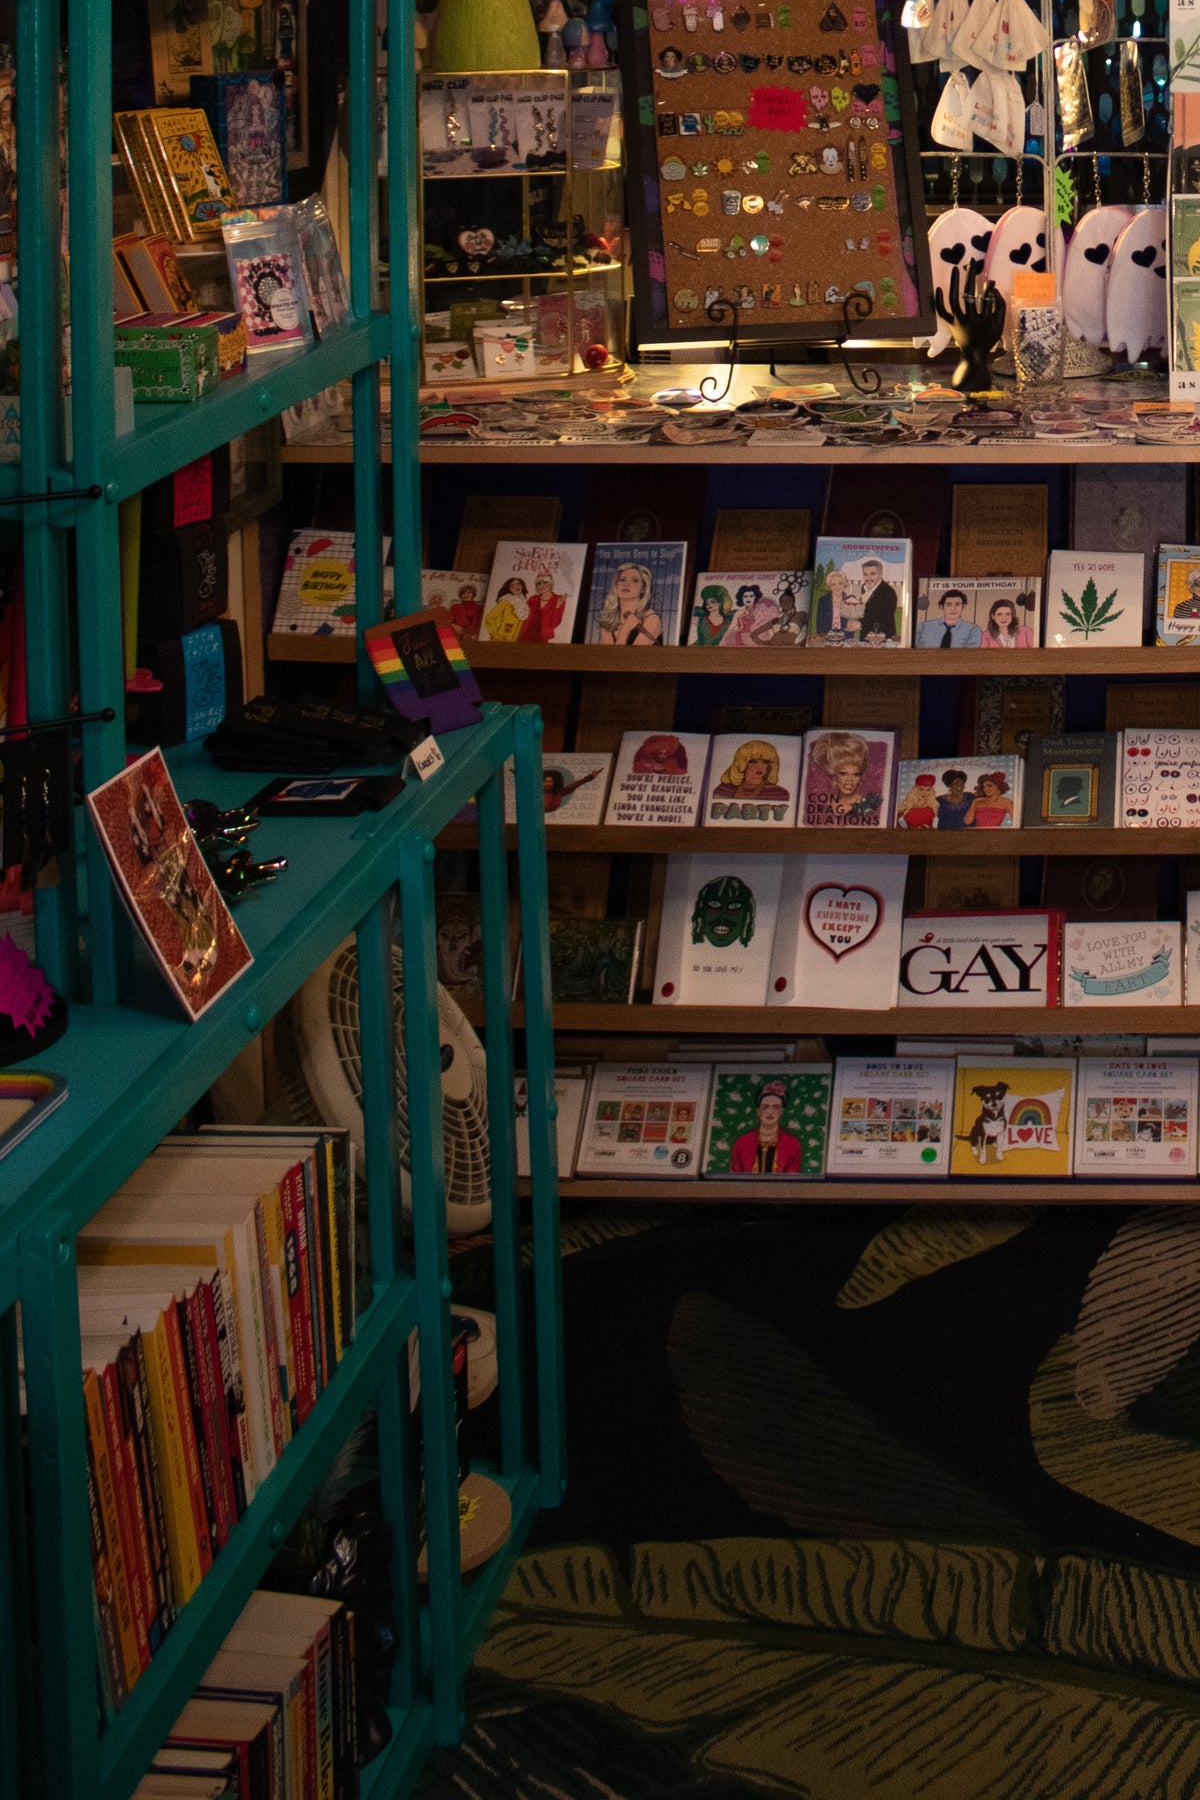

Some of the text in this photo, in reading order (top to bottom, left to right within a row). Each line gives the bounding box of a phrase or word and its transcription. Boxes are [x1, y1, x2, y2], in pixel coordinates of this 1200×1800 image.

[1168, 621, 1195, 634] Happy
[628, 794, 667, 803] YOU LOOK
[807, 793, 840, 803] CON
[711, 802, 789, 821] PARTY
[807, 804, 845, 815] DRAG
[648, 813, 655, 821] A
[807, 815, 880, 826] ULATIONS
[836, 901, 861, 910] HATE
[816, 910, 869, 922] EVERYONE
[822, 923, 861, 933] EXCEPT
[829, 934, 851, 944] YOU
[1087, 931, 1147, 952] LOVE YOU
[1103, 946, 1136, 960] WITH
[900, 944, 1047, 994] GAY
[1100, 956, 1145, 974] ALL MY
[1110, 1062, 1131, 1070] CATS
[1147, 1062, 1168, 1070] LOVE
[285, 1236, 298, 1293] 1968
[211, 1273, 232, 1341] STEVE
[96, 1452, 113, 1506] QUEER
[104, 1512, 119, 1550] LOVE
